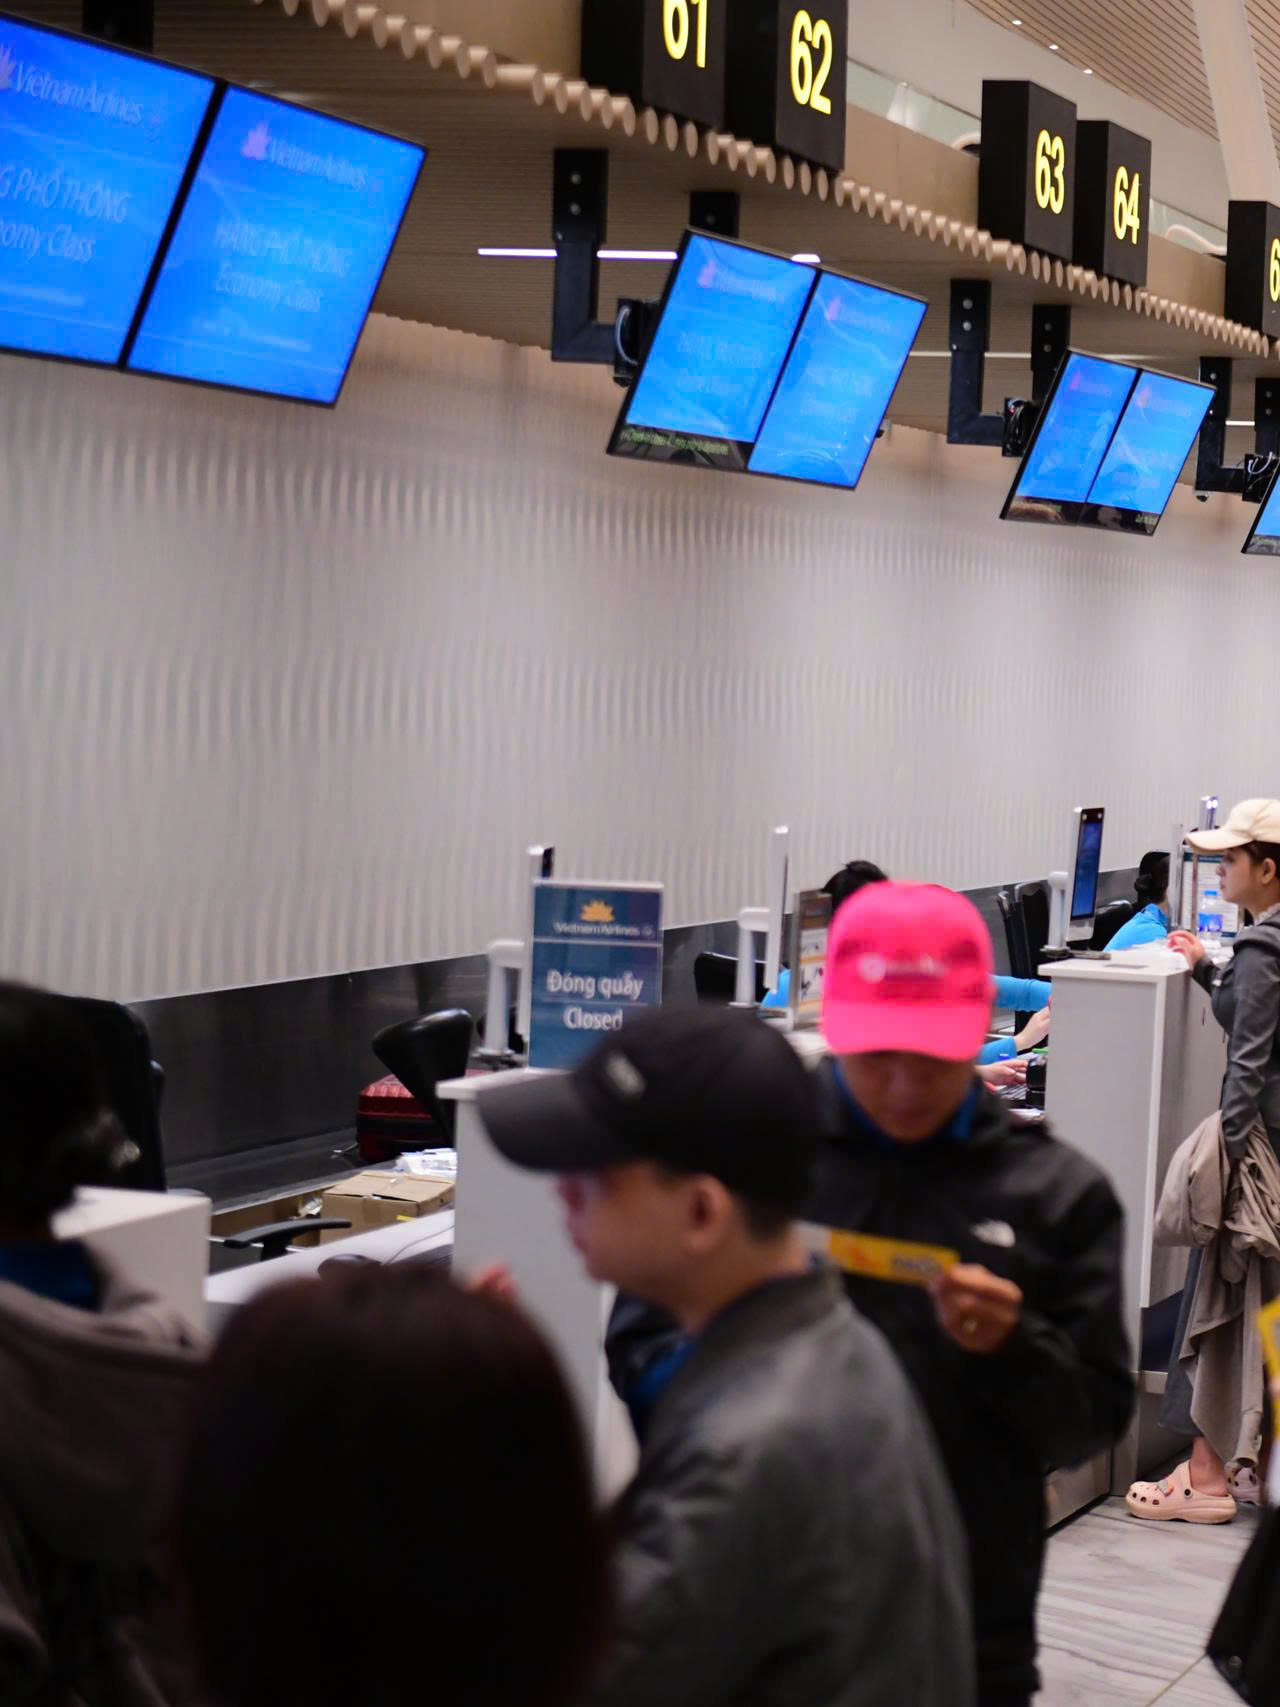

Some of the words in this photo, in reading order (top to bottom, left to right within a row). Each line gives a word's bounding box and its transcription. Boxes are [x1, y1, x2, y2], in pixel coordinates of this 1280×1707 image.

[663, 0, 708, 68] 61
[790, 9, 833, 115] 62
[1035, 129, 1065, 214] 63
[1113, 165, 1140, 245] 64
[547, 968, 596, 999] Đóng
[563, 1005, 624, 1031] Closed
